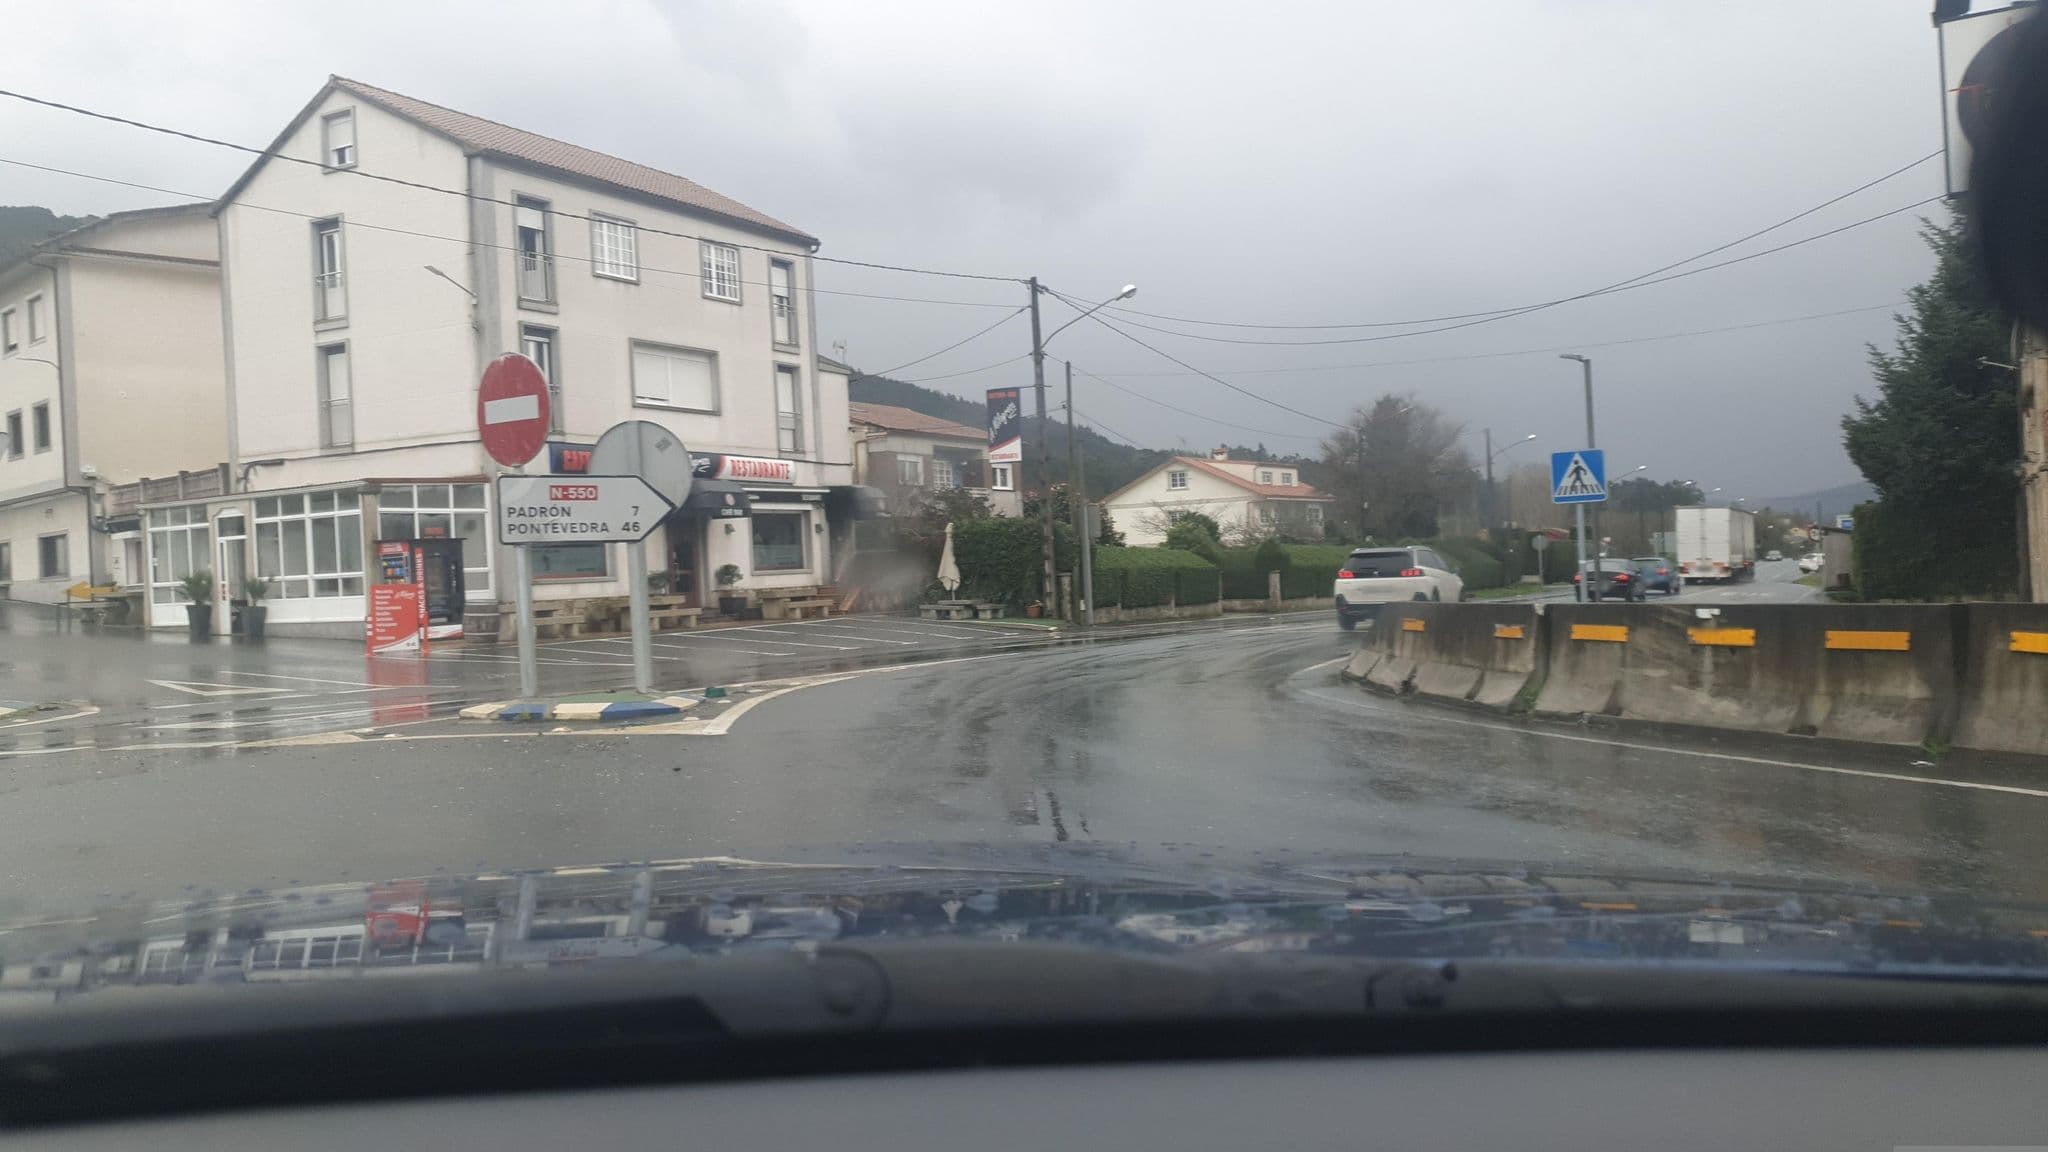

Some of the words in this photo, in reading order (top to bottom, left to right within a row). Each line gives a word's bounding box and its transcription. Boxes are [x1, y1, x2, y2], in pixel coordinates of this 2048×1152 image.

[731, 460, 789, 479] RESTAURANTE
[551, 486, 597, 499] N-550
[507, 504, 572, 518] PADRÓN
[631, 505, 640, 517] 7
[508, 522, 610, 535] PONTEVEDRA
[621, 521, 641, 533] 46
